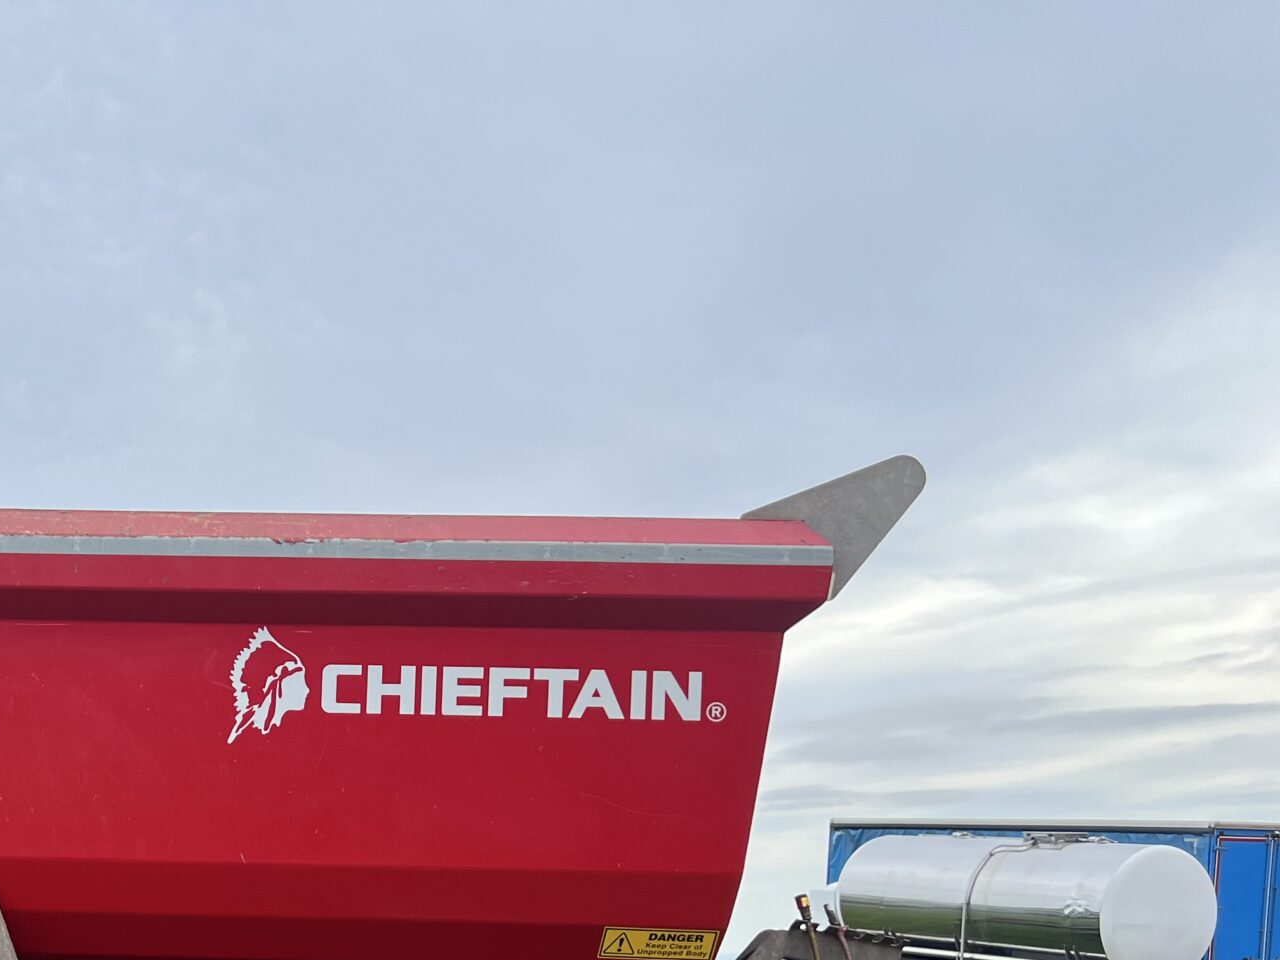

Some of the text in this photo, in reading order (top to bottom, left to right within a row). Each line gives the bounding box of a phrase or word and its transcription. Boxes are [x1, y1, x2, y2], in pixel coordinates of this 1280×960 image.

[321, 664, 702, 721] CHIEFTAIN
[648, 933, 704, 942] DANGER
[637, 949, 683, 957] Unpropped
